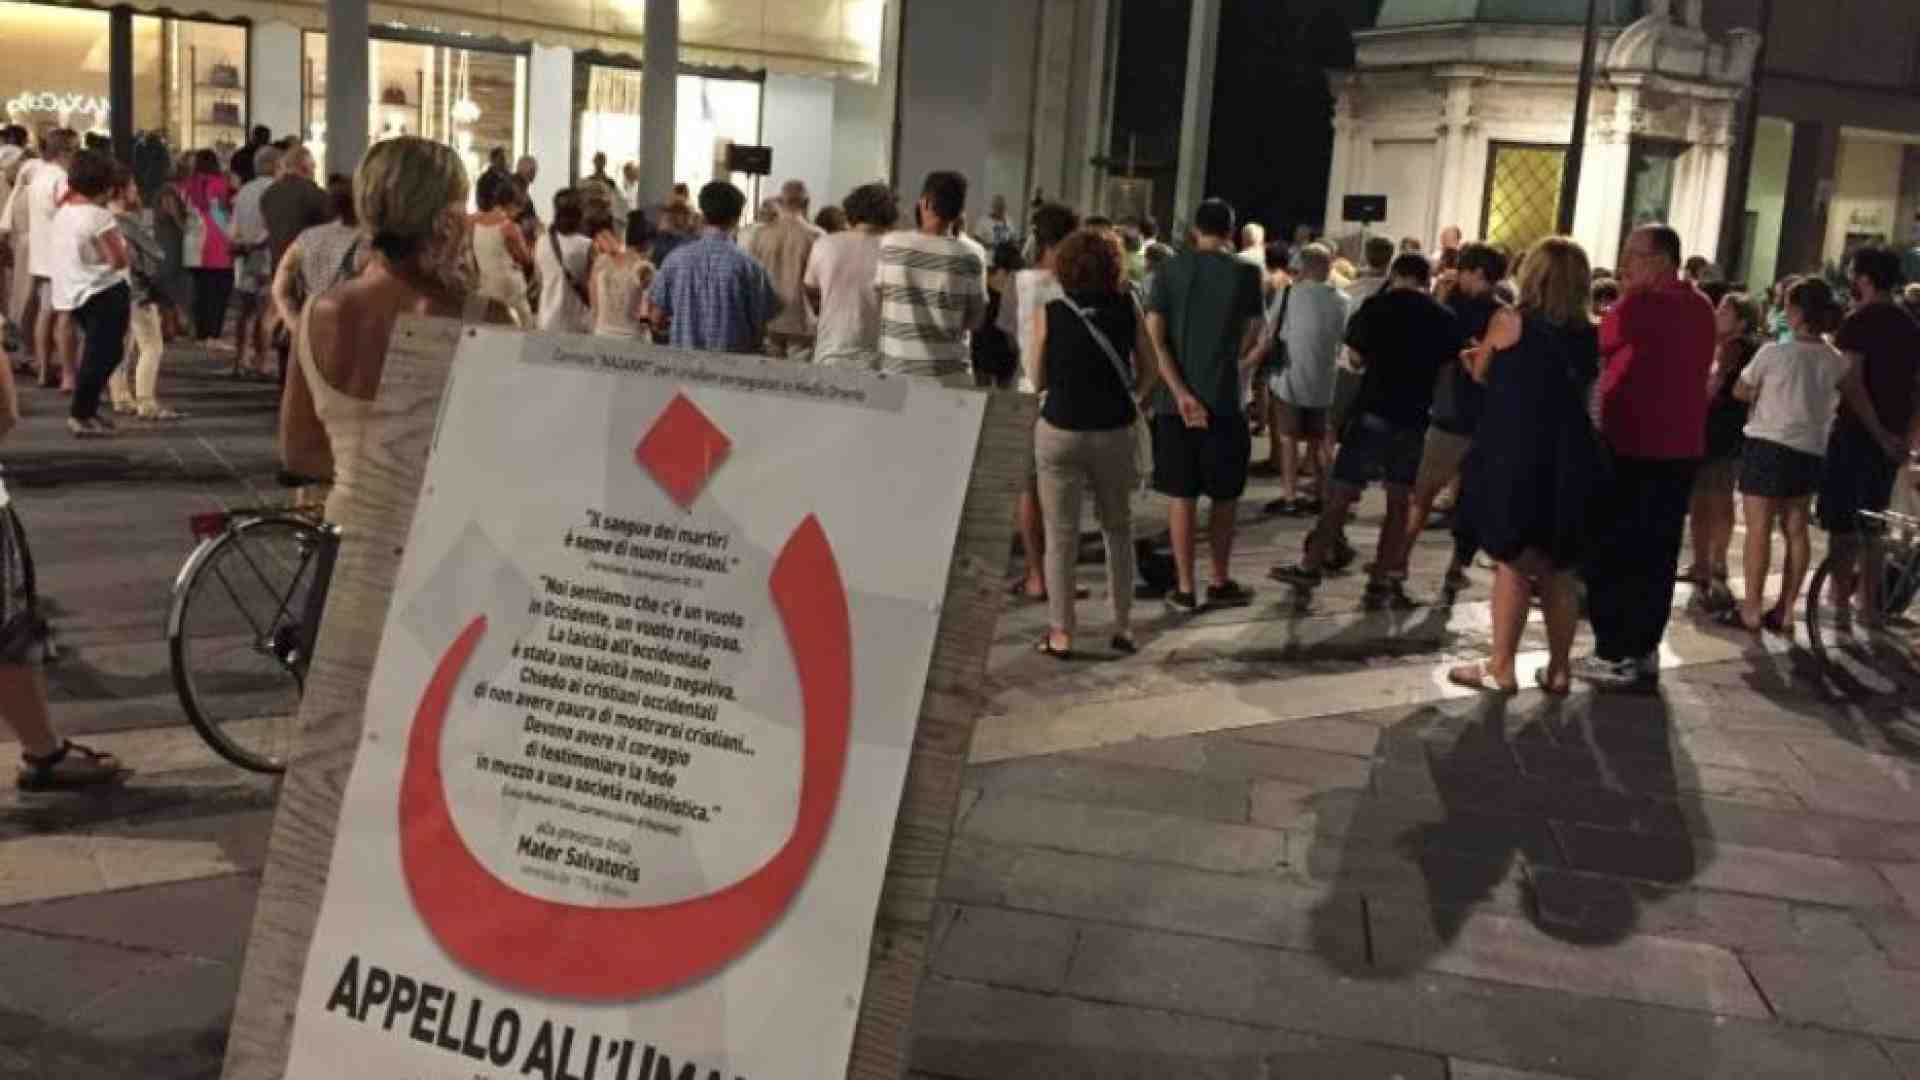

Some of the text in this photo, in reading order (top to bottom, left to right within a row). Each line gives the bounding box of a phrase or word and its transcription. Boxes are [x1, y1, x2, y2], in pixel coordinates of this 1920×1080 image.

[575, 536, 612, 554] seme
[613, 540, 628, 556] di
[629, 544, 669, 563] nuovi
[603, 516, 652, 537] sangue
[654, 523, 678, 541] dei
[679, 528, 729, 550] martiri
[528, 597, 541, 615] in
[614, 617, 633, 632] un
[569, 582, 631, 607] sentiamo
[634, 594, 659, 611] che
[684, 606, 703, 620] un
[548, 624, 565, 643] La
[522, 646, 556, 664] stata
[558, 653, 584, 670] una
[630, 666, 672, 688] molto
[473, 681, 488, 698] di
[489, 686, 513, 703] non
[515, 692, 554, 711] avere
[555, 700, 597, 720] paura
[598, 706, 612, 724] di
[613, 711, 684, 740] mostrarsi
[520, 666, 718, 722] Chiedo ai cristiani occidentali
[524, 715, 691, 768] Devono avere il coraggio
[477, 754, 489, 771] in
[491, 758, 534, 780] mezzo
[535, 769, 544, 784] a
[547, 771, 573, 789] una
[525, 741, 677, 789] di testimoniare la fede
[517, 834, 563, 862] Mater
[564, 846, 641, 883] Salvatoris
[326, 955, 520, 1067] APPELLO
